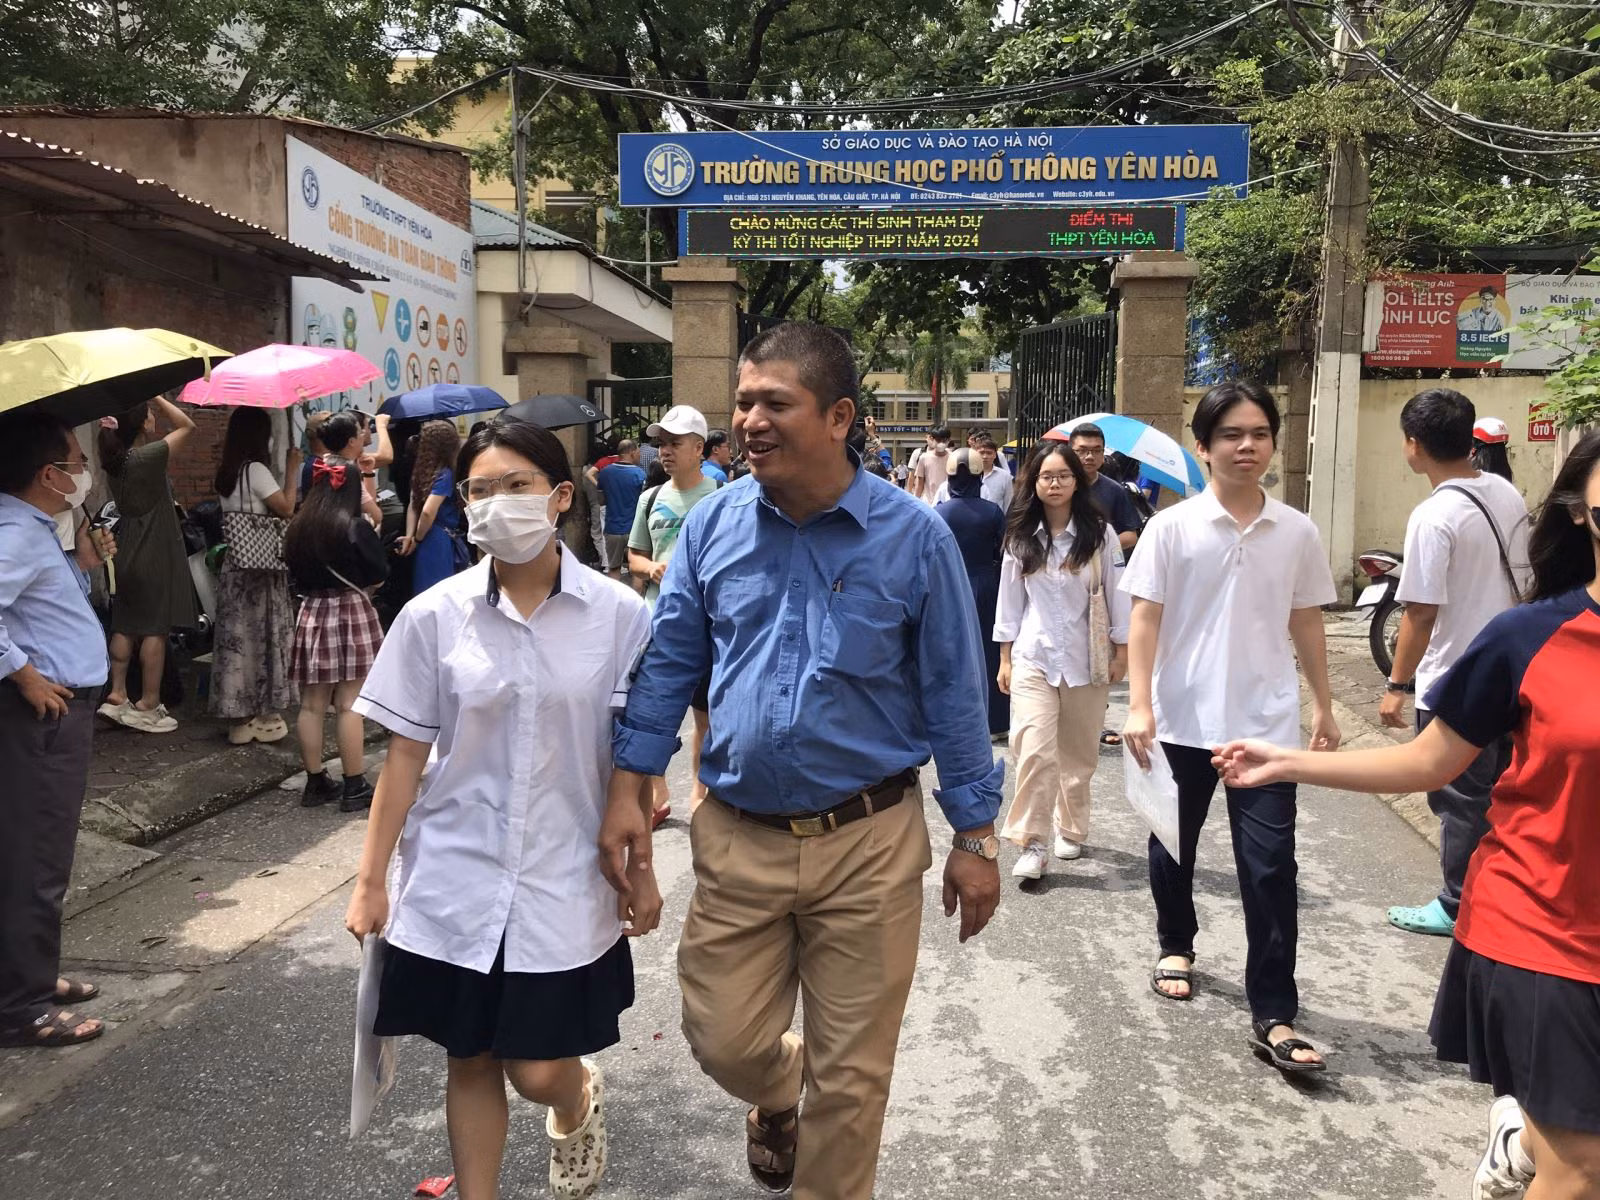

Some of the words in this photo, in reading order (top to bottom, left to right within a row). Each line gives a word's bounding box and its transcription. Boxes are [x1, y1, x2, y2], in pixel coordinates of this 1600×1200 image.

[822, 134, 841, 149] SỞ
[845, 133, 880, 149] GIÁO
[884, 138, 912, 152] DỤC
[918, 132, 934, 148] VÀ
[938, 132, 967, 148] ĐÀO
[972, 136, 999, 151] TẠO
[1004, 131, 1023, 147] HÀ
[1028, 132, 1053, 150] NỘI
[700, 154, 800, 184] TRƯỜNG
[806, 160, 890, 184] TRUNG
[895, 159, 946, 188] HỌC
[951, 149, 1005, 182] PHỔ
[1010, 152, 1097, 181] THÔNG
[1104, 151, 1157, 179] YÊN
[1163, 149, 1219, 179] HÒA
[730, 214, 771, 230] CHÀO
[774, 214, 817, 230] MỪNG
[820, 213, 847, 229] CÁC
[850, 213, 874, 229] THÍ
[877, 216, 911, 229] SINH
[915, 215, 956, 228] THAM
[960, 215, 983, 231] DỰ
[1069, 210, 1105, 226] ĐIỂM
[1109, 213, 1134, 225] THI
[733, 233, 752, 249] KỲ
[754, 235, 777, 249] THI
[780, 232, 807, 248] TỐT
[810, 232, 863, 251] NGHIỆP
[866, 234, 903, 248] THPT
[906, 231, 940, 247] NĂM
[943, 234, 979, 247] 2024
[1047, 231, 1085, 245] THPT
[1089, 228, 1118, 245] YÊN
[1121, 228, 1156, 245] HÒA
[1385, 292, 1409, 306] OL
[1413, 292, 1455, 306] IELTS
[1550, 295, 1569, 304] Khi
[1383, 306, 1413, 324] ÌNH
[1418, 310, 1451, 327] LỰC
[1460, 333, 1477, 342] 8.5
[1479, 333, 1508, 342] IELTS
